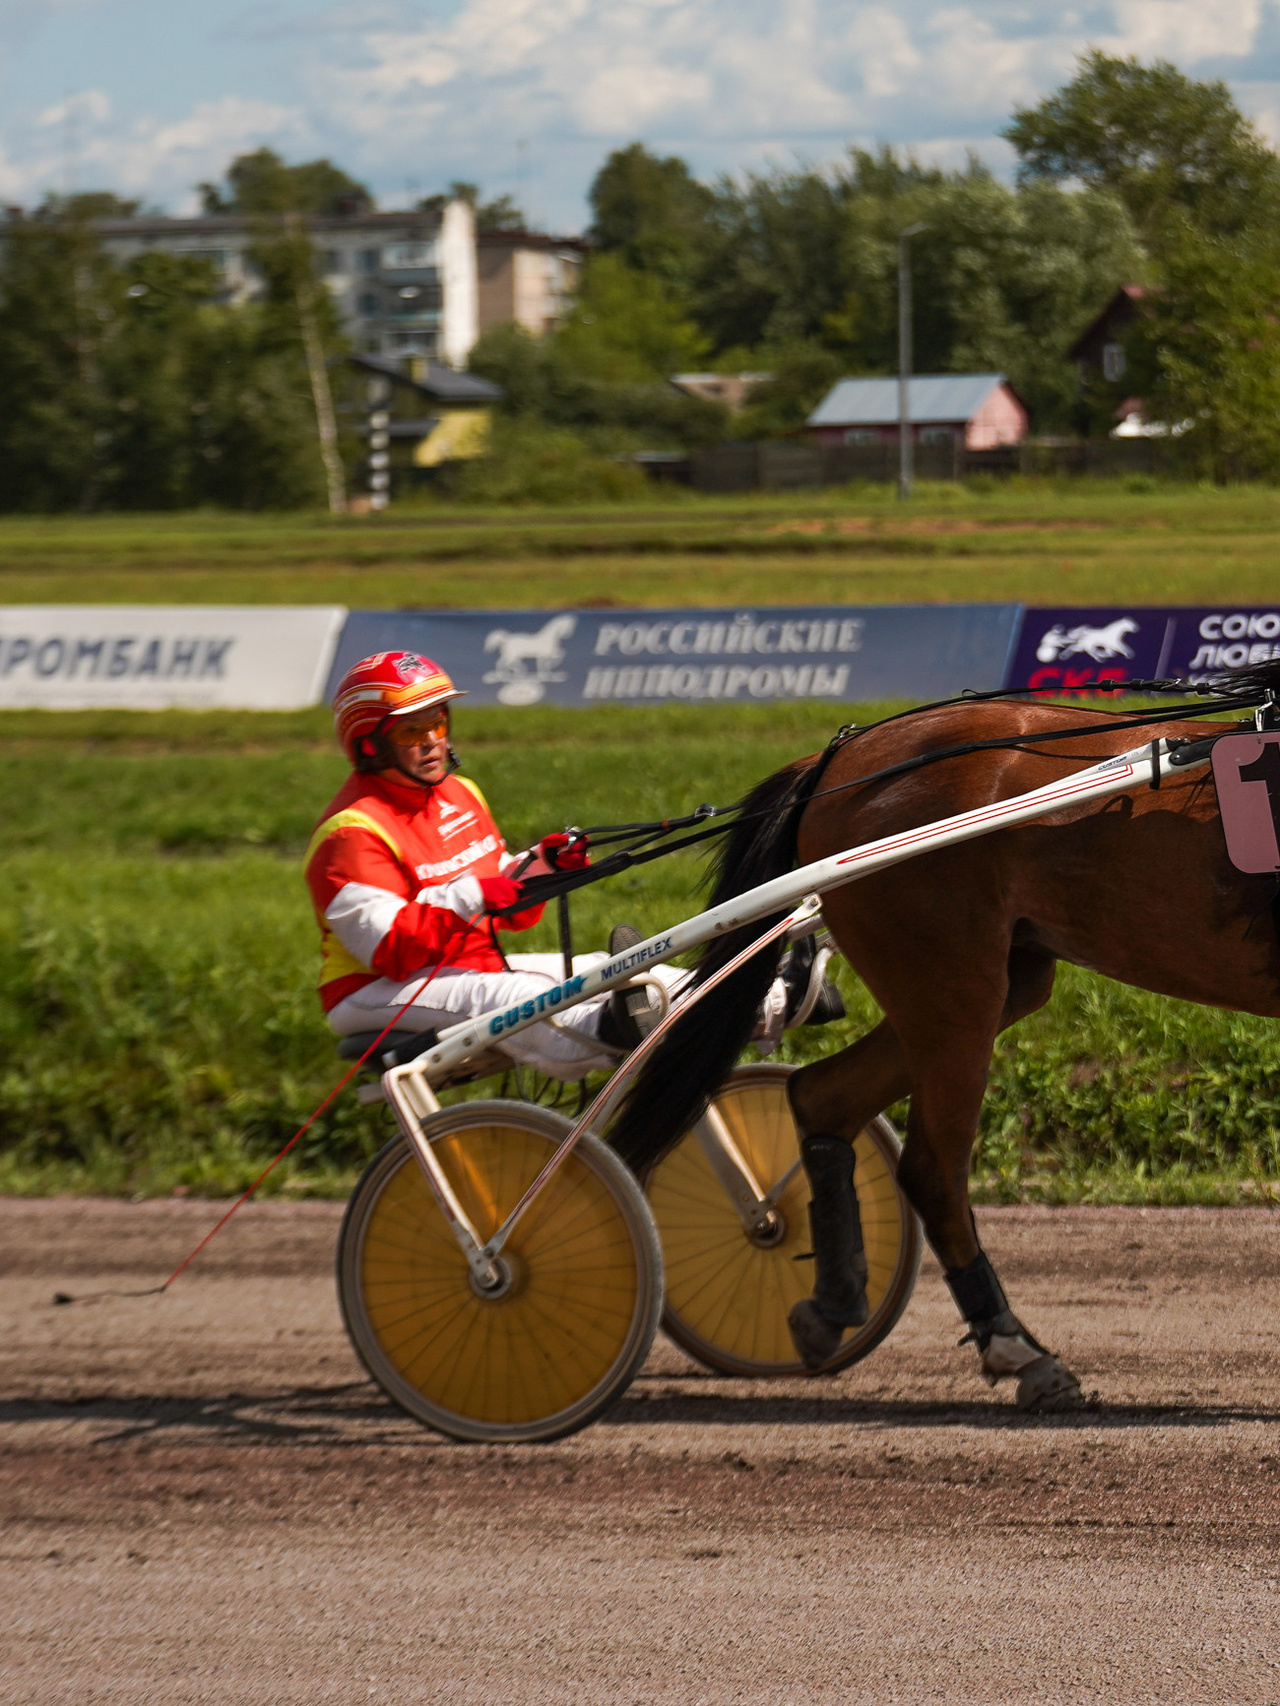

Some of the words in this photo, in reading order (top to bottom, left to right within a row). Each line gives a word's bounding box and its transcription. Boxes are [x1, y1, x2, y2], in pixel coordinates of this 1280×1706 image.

[594, 611, 867, 656] РОССИЙСКИЕ
[0, 635, 235, 682] РОМБАНК
[583, 663, 850, 699] ИППОДРОМЫ
[488, 975, 588, 1037] CUSTOM
[600, 936, 674, 982] MULTIFLEX
